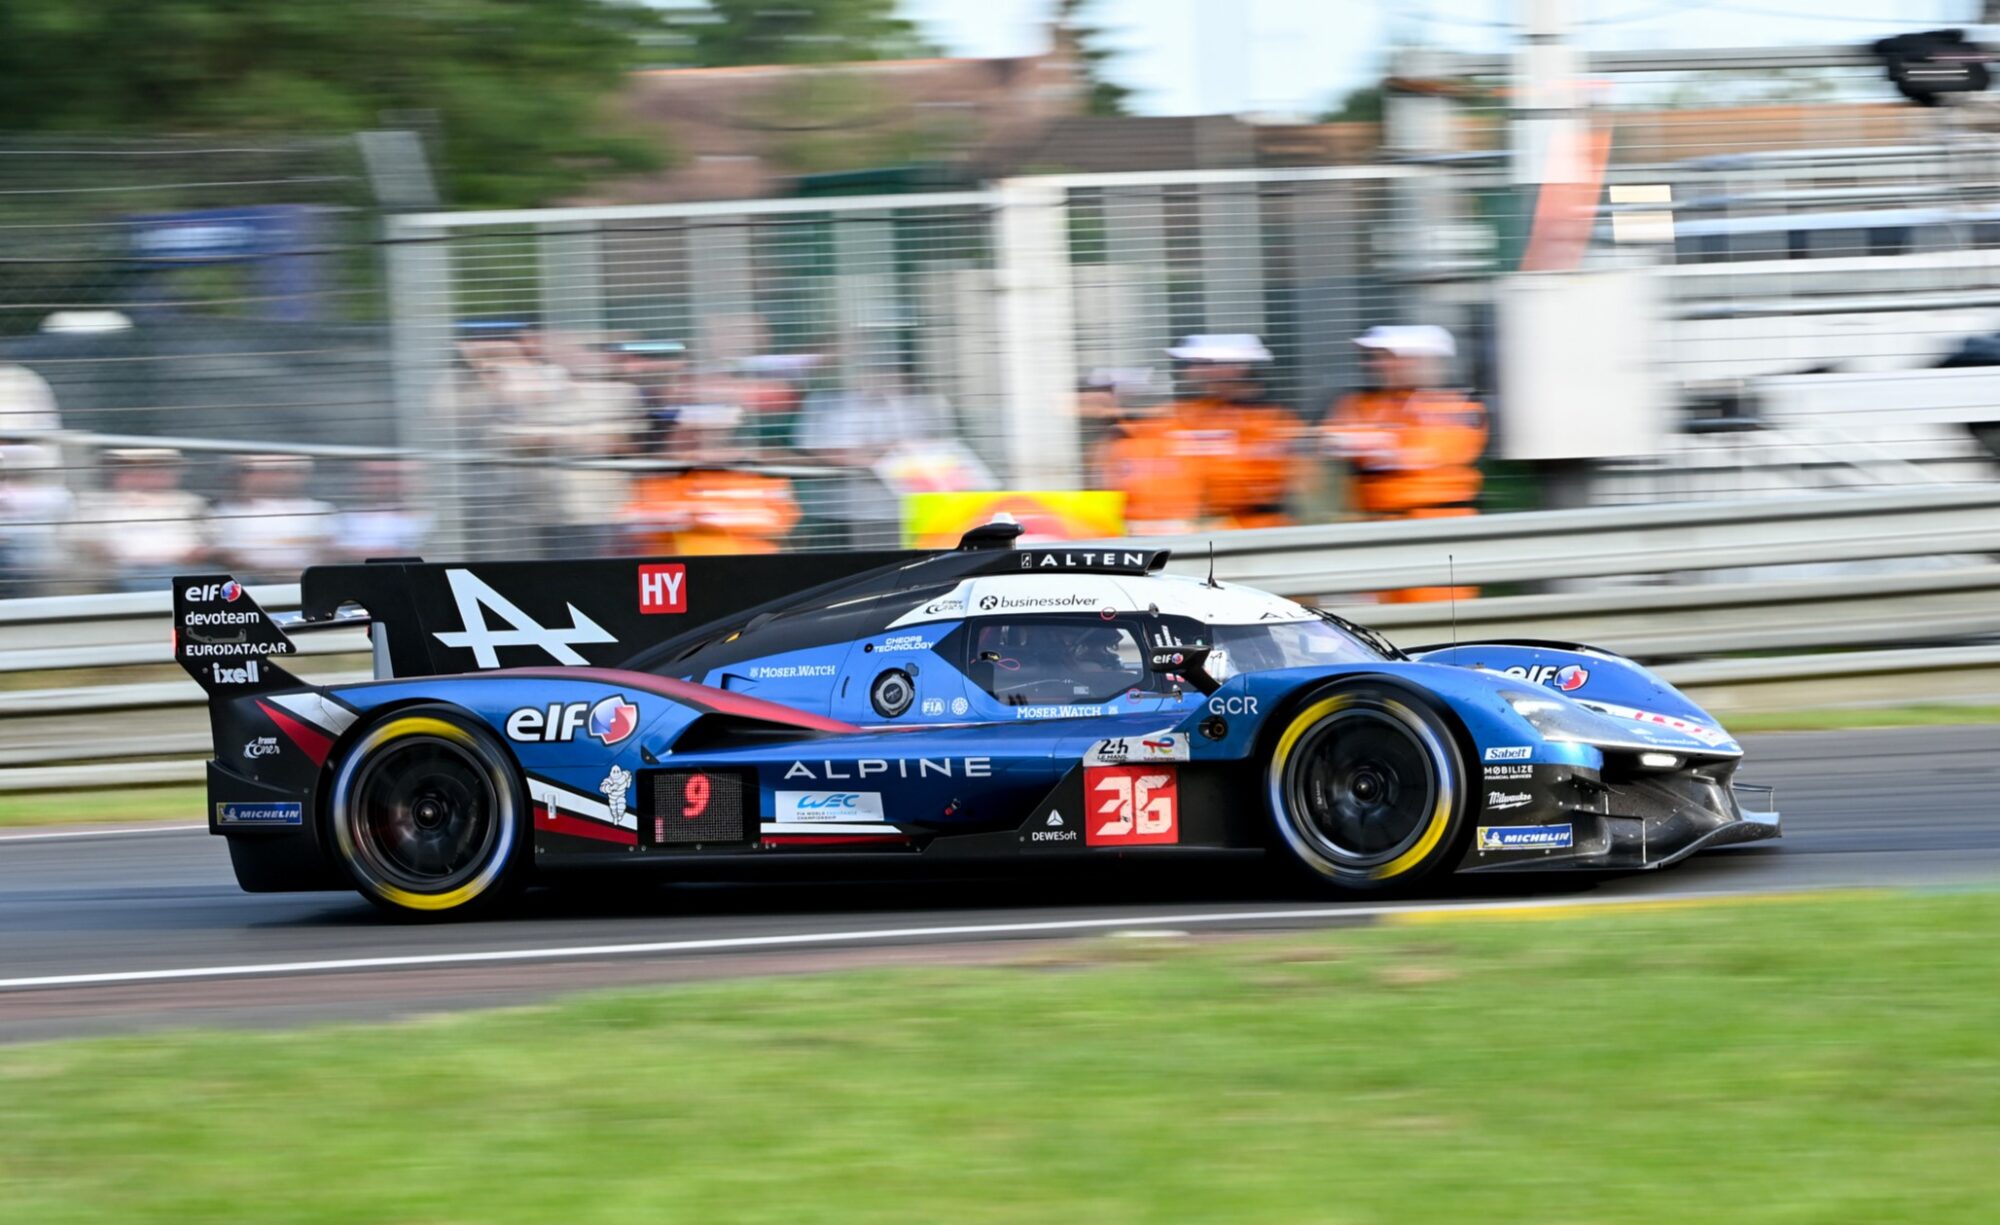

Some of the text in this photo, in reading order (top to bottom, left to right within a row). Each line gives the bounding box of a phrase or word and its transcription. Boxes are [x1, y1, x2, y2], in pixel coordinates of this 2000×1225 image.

[1040, 553, 1143, 567] ALTEN
[185, 584, 220, 602] elf
[641, 572, 683, 606] HY
[1000, 594, 1099, 609] businessolver
[185, 611, 260, 626] devoteam
[185, 642, 287, 656] EURODATACAR
[874, 641, 934, 653] TECHNOLOGY
[1153, 653, 1172, 664] elf
[213, 661, 260, 684] ixell
[923, 701, 943, 714] FIA
[1208, 696, 1259, 715] GCR
[506, 703, 588, 742] elf
[1490, 748, 1528, 759] Sabelt
[784, 757, 992, 779] ALPINE
[682, 773, 712, 818] 9
[797, 793, 860, 809] WEC
[1094, 774, 1172, 836] 36
[240, 809, 299, 819] MICHELIN
[1032, 830, 1077, 842] DEWESoft
[1504, 831, 1570, 843] MICHELIN
